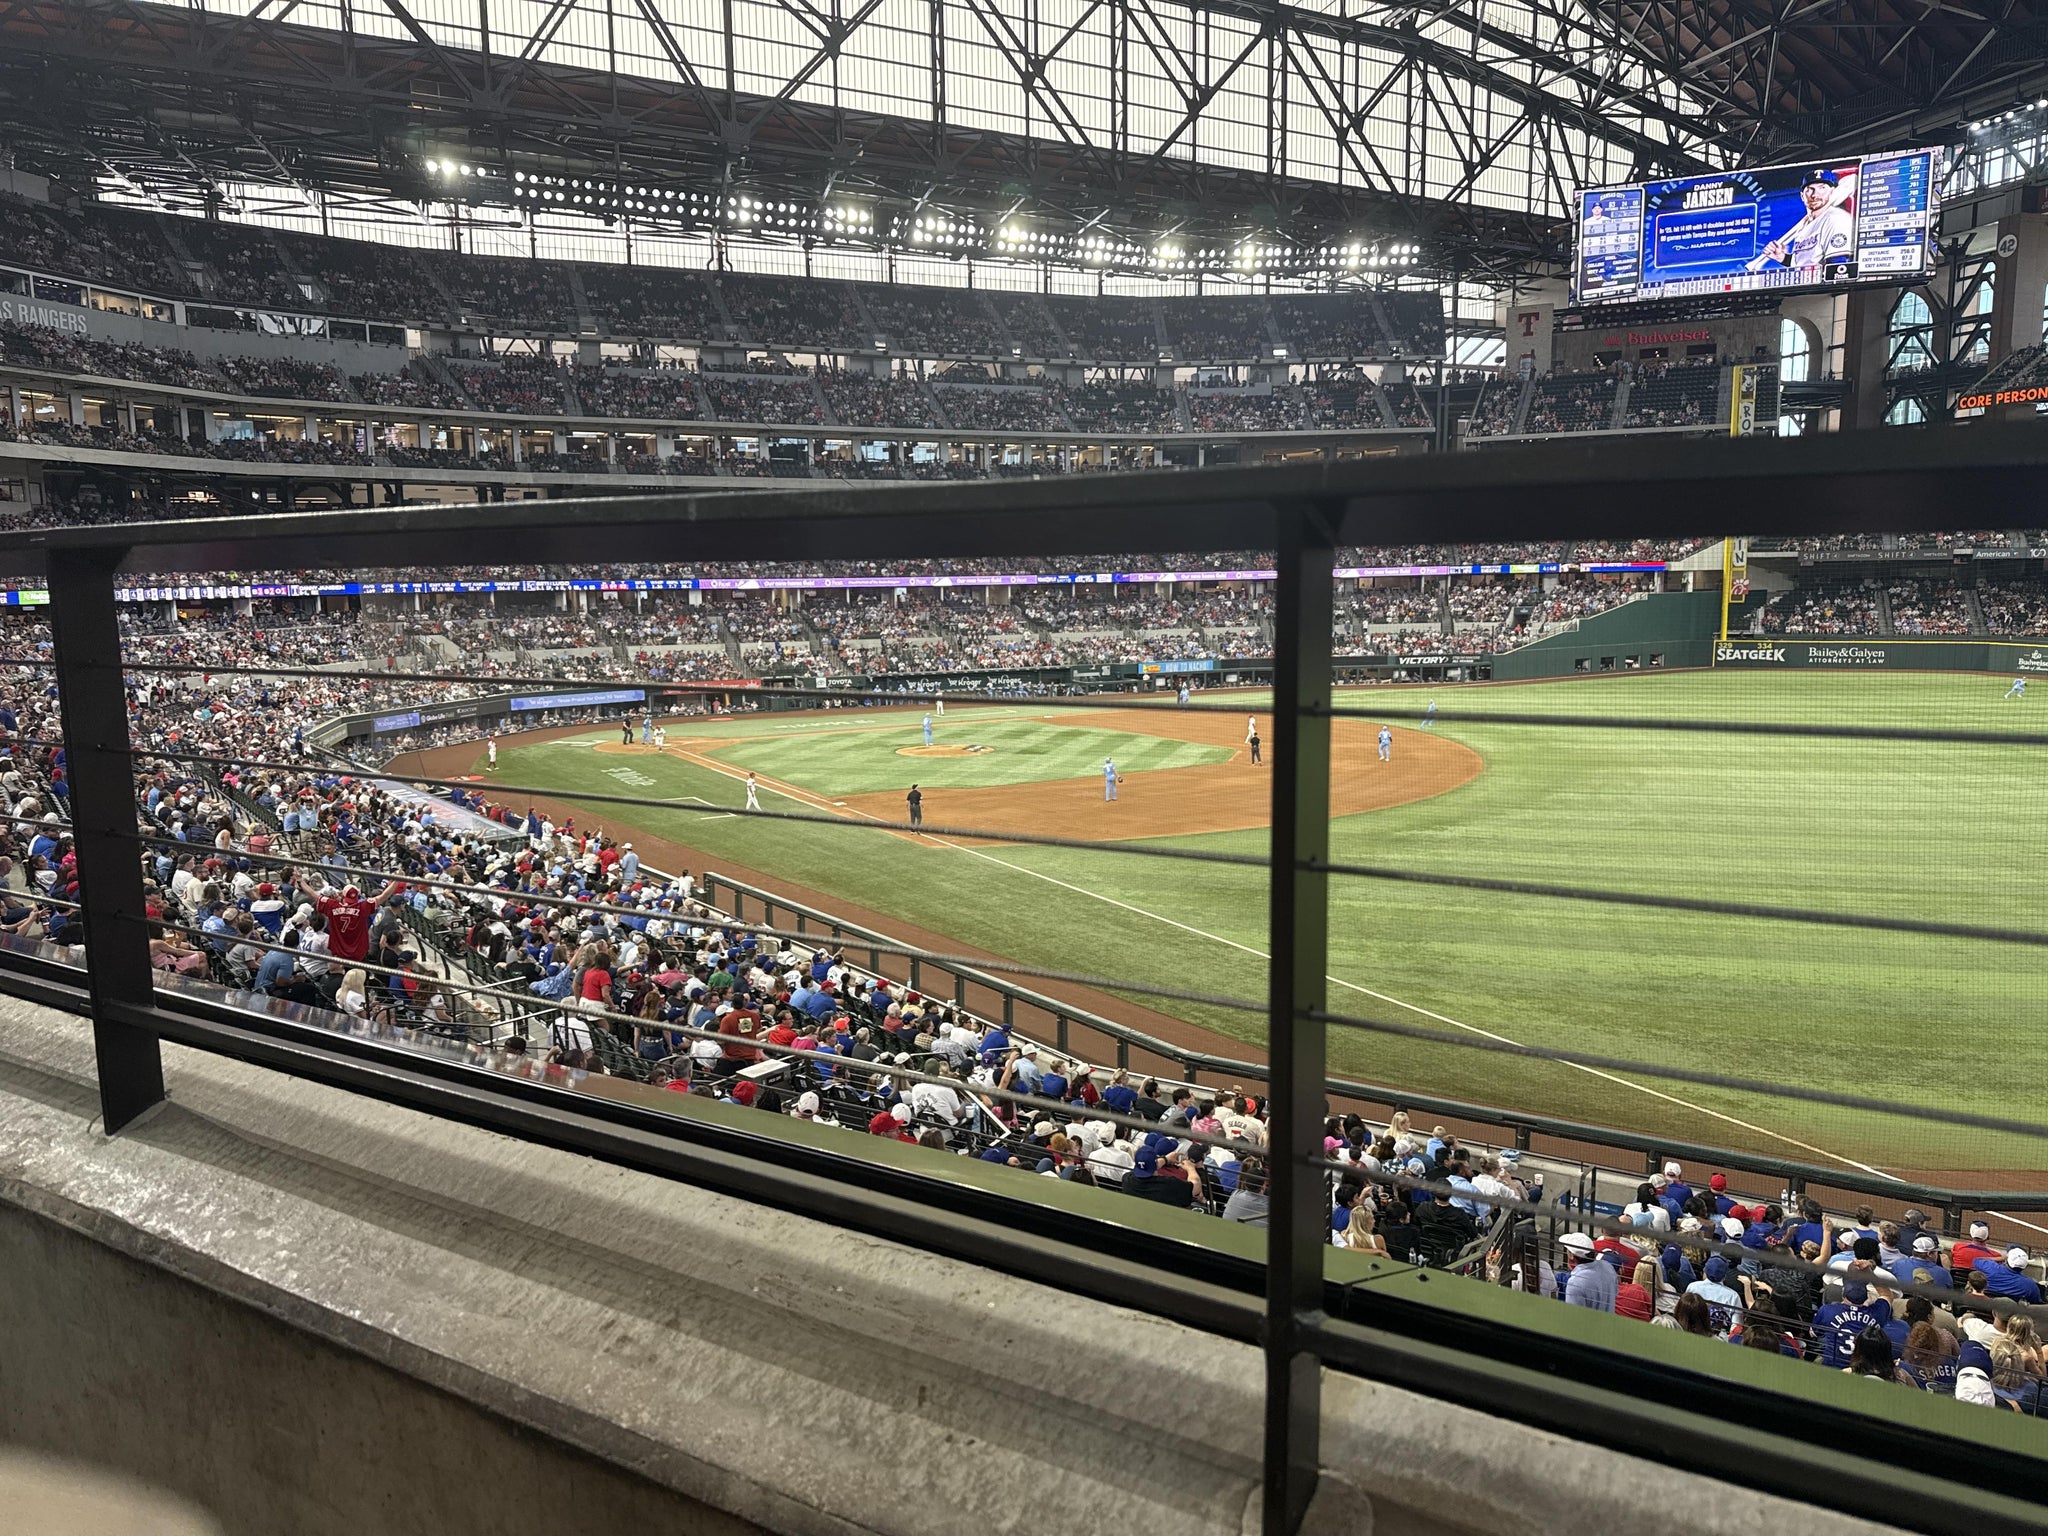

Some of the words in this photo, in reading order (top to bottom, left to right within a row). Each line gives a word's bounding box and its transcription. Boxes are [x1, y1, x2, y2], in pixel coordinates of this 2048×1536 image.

[1694, 181, 1723, 191] DANNY
[1682, 187, 1734, 209] JANSEN
[1667, 234, 1681, 242] games
[1682, 232, 1692, 240] with
[1692, 231, 1707, 239] Tampa
[2000, 239, 2016, 253] 42
[0, 301, 13, 319] S
[18, 303, 87, 333] RANGERS
[1518, 312, 1540, 337] T
[1960, 394, 1992, 409] CORE
[1976, 550, 2010, 558] American
[1399, 656, 1445, 665] VICTORY
[1717, 648, 1786, 662] SEATGEEK
[1808, 647, 1885, 658] Bailey&Galyen
[958, 676, 982, 690] Kroger
[427, 714, 438, 722] Globe
[340, 916, 351, 933] 7
[620, 999, 628, 1013] 5
[1227, 1120, 1248, 1130] SEAGER
[1138, 1161, 1146, 1169] T
[1830, 1310, 1882, 1330] LANGFORD
